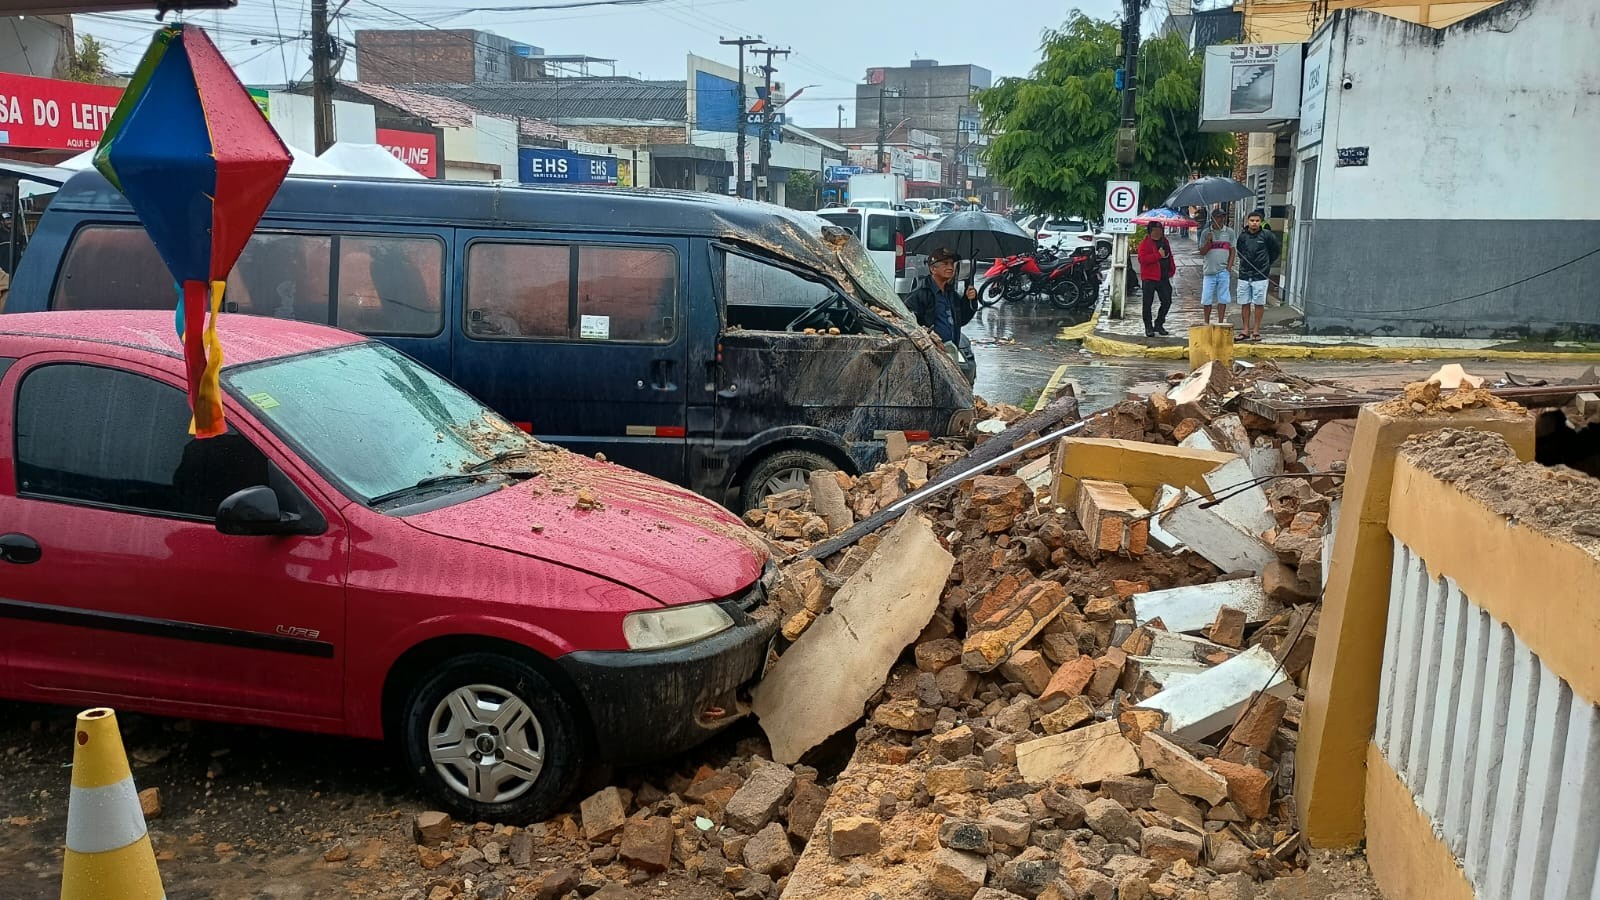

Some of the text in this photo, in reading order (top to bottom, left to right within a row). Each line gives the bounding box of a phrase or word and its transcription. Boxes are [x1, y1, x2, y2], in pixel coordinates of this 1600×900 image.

[33, 99, 59, 127] DO
[747, 114, 781, 123] CAIA
[67, 139, 84, 148] AQUI
[532, 158, 568, 173] EHS
[591, 159, 607, 176] EHS
[1117, 192, 1127, 207] E
[276, 624, 320, 639] LIFE
